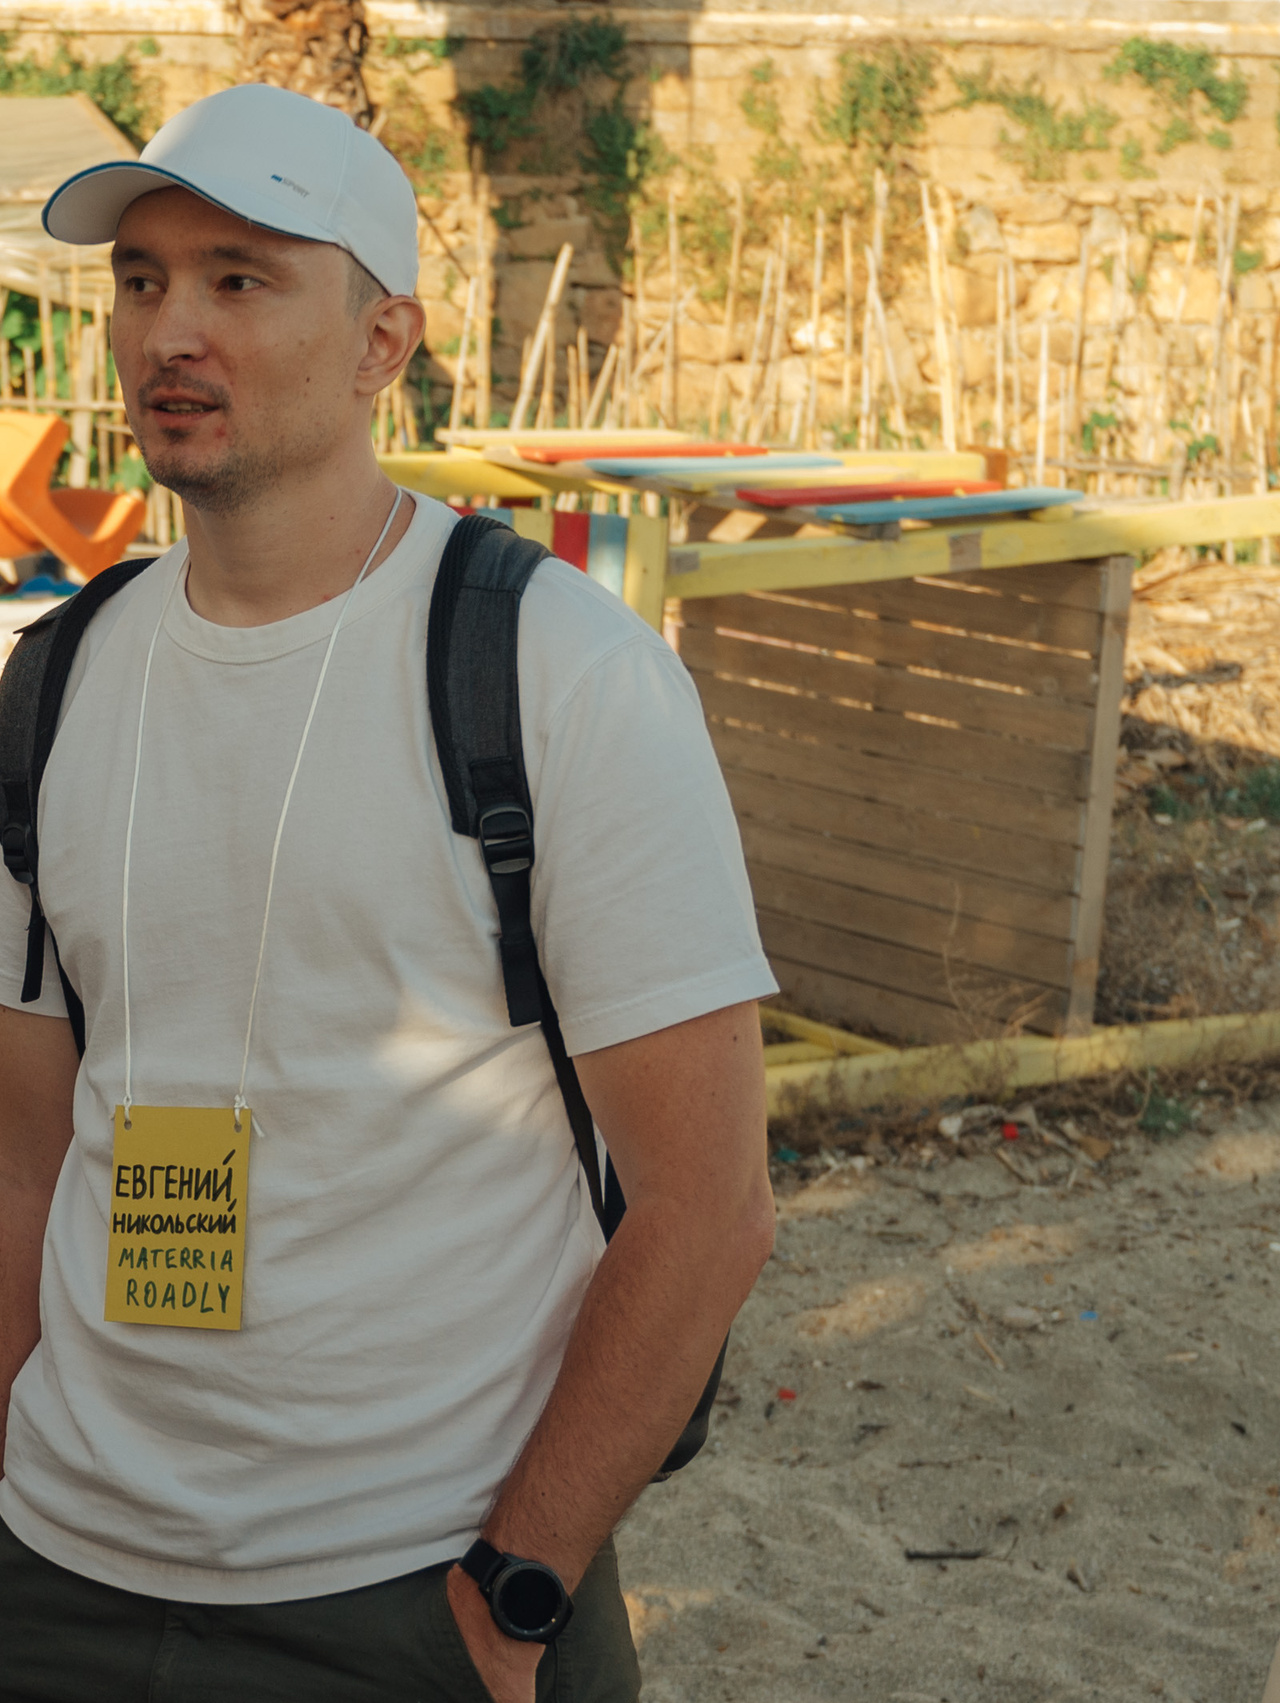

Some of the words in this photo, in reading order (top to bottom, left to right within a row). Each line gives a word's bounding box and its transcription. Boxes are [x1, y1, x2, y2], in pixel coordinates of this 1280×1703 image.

[116, 1149, 236, 1202] ЕВГЕНИЙ
[112, 1199, 237, 1235] НИКОЛЬСКИЙ
[118, 1247, 234, 1272] MATERRIA
[126, 1278, 231, 1313] ROADLY
